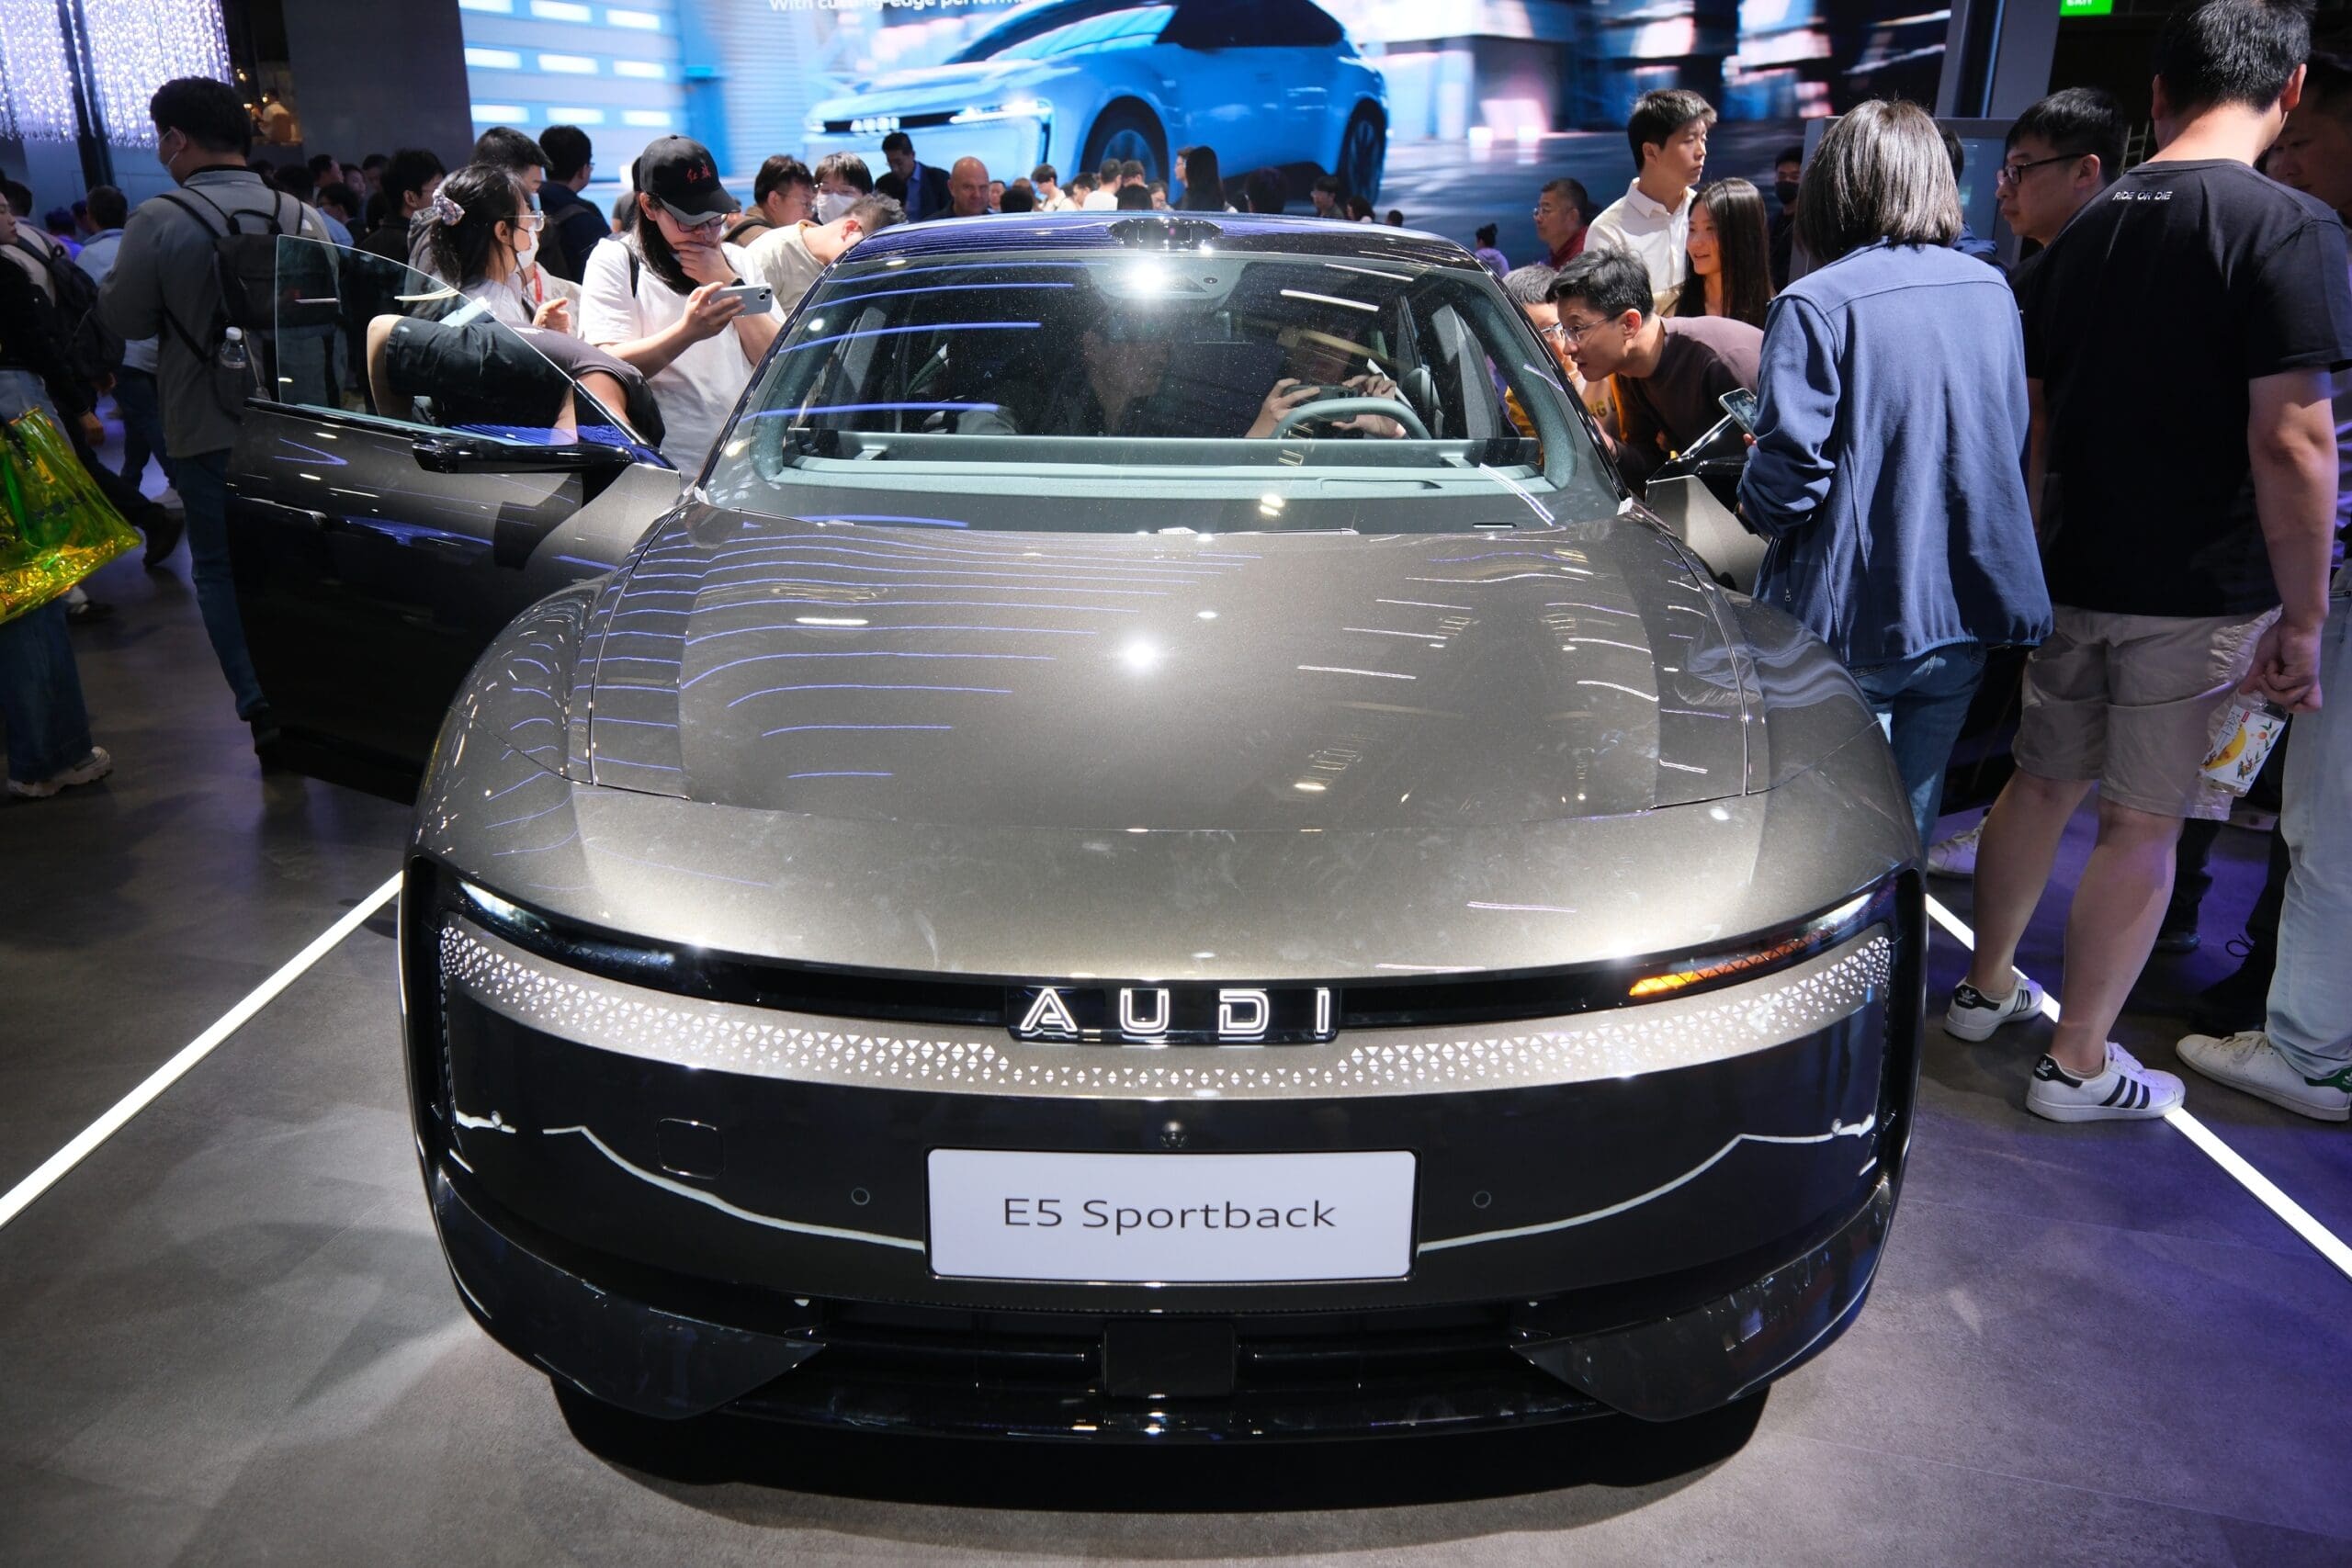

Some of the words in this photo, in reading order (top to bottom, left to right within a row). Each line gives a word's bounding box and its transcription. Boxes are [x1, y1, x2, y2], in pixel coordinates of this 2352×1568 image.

[2112, 191, 2134, 200] RIDE
[2137, 191, 2152, 200] OR
[2154, 191, 2173, 200] DIE
[1020, 987, 1330, 1033] AUDI
[1004, 1198, 1062, 1227] E5
[1082, 1200, 1337, 1235] Sportback
